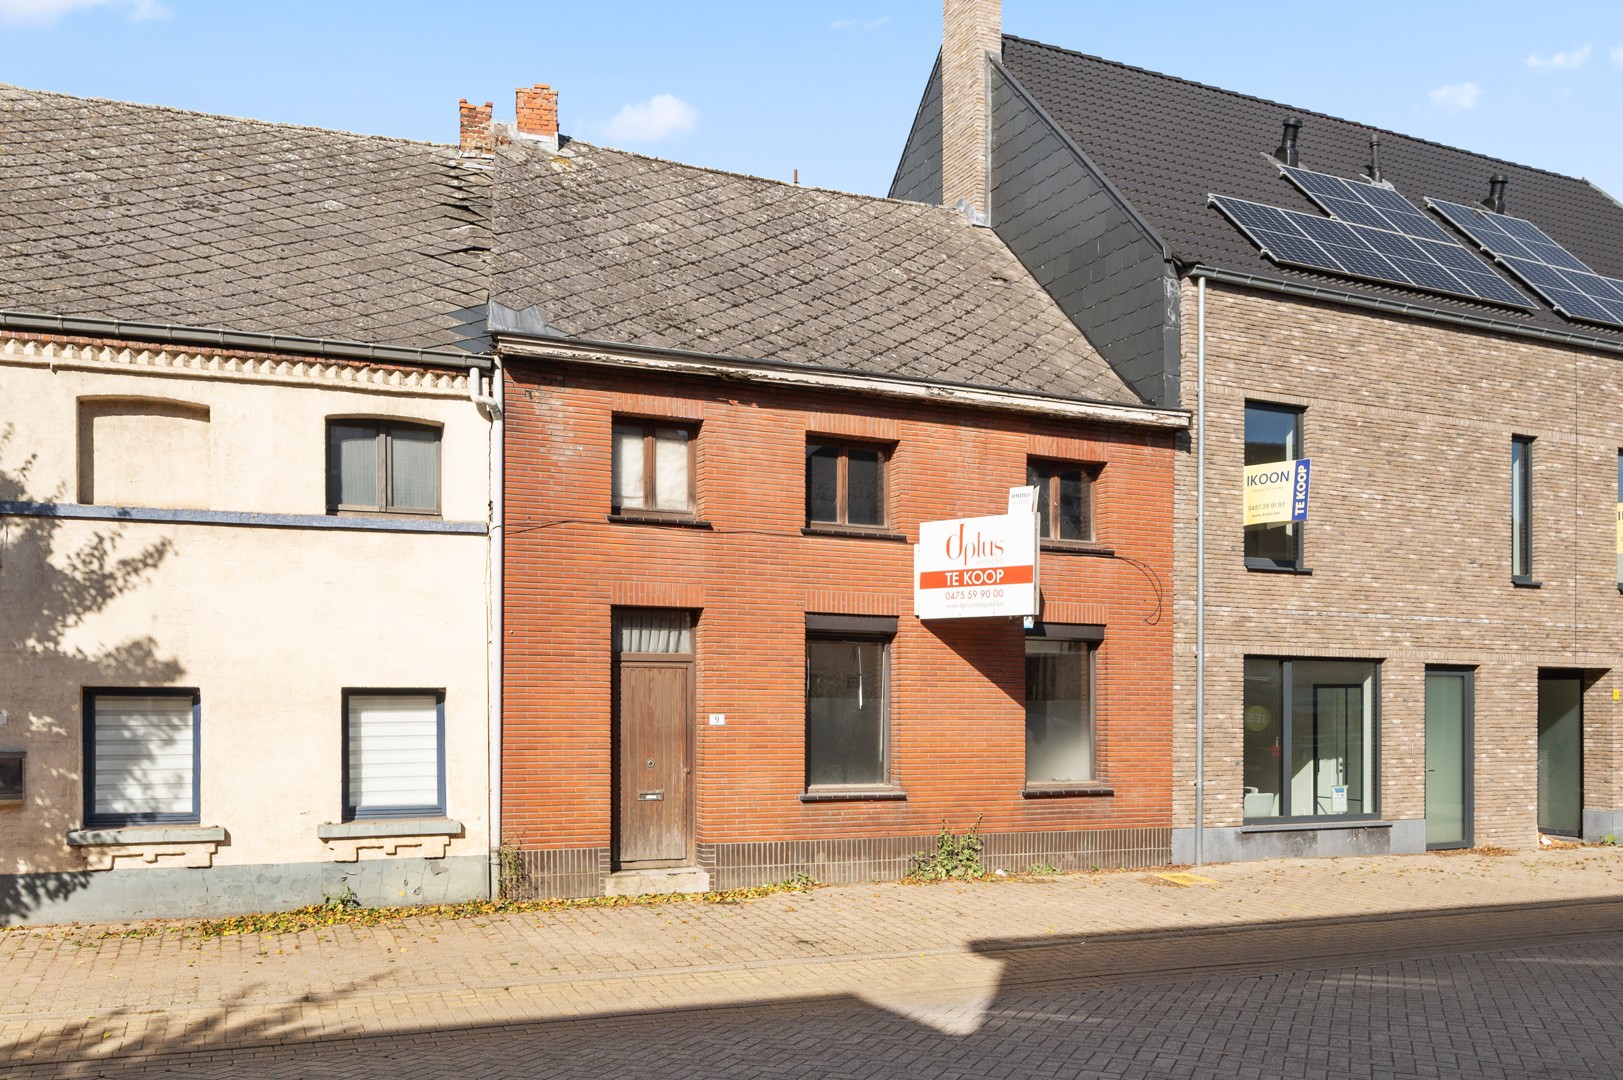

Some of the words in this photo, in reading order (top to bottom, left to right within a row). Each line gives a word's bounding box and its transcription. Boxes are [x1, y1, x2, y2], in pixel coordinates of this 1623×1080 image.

[1247, 470, 1290, 487] IKOON
[1296, 465, 1307, 500] KOOP
[1295, 501, 1305, 516] TE
[945, 523, 1004, 566] dplus
[945, 572, 960, 587] TE
[963, 569, 1004, 585] KOOP
[945, 591, 965, 601] 0475
[967, 590, 978, 600] 59
[980, 589, 991, 599] 90
[993, 588, 1004, 598] 00
[714, 715, 720, 724] 9
